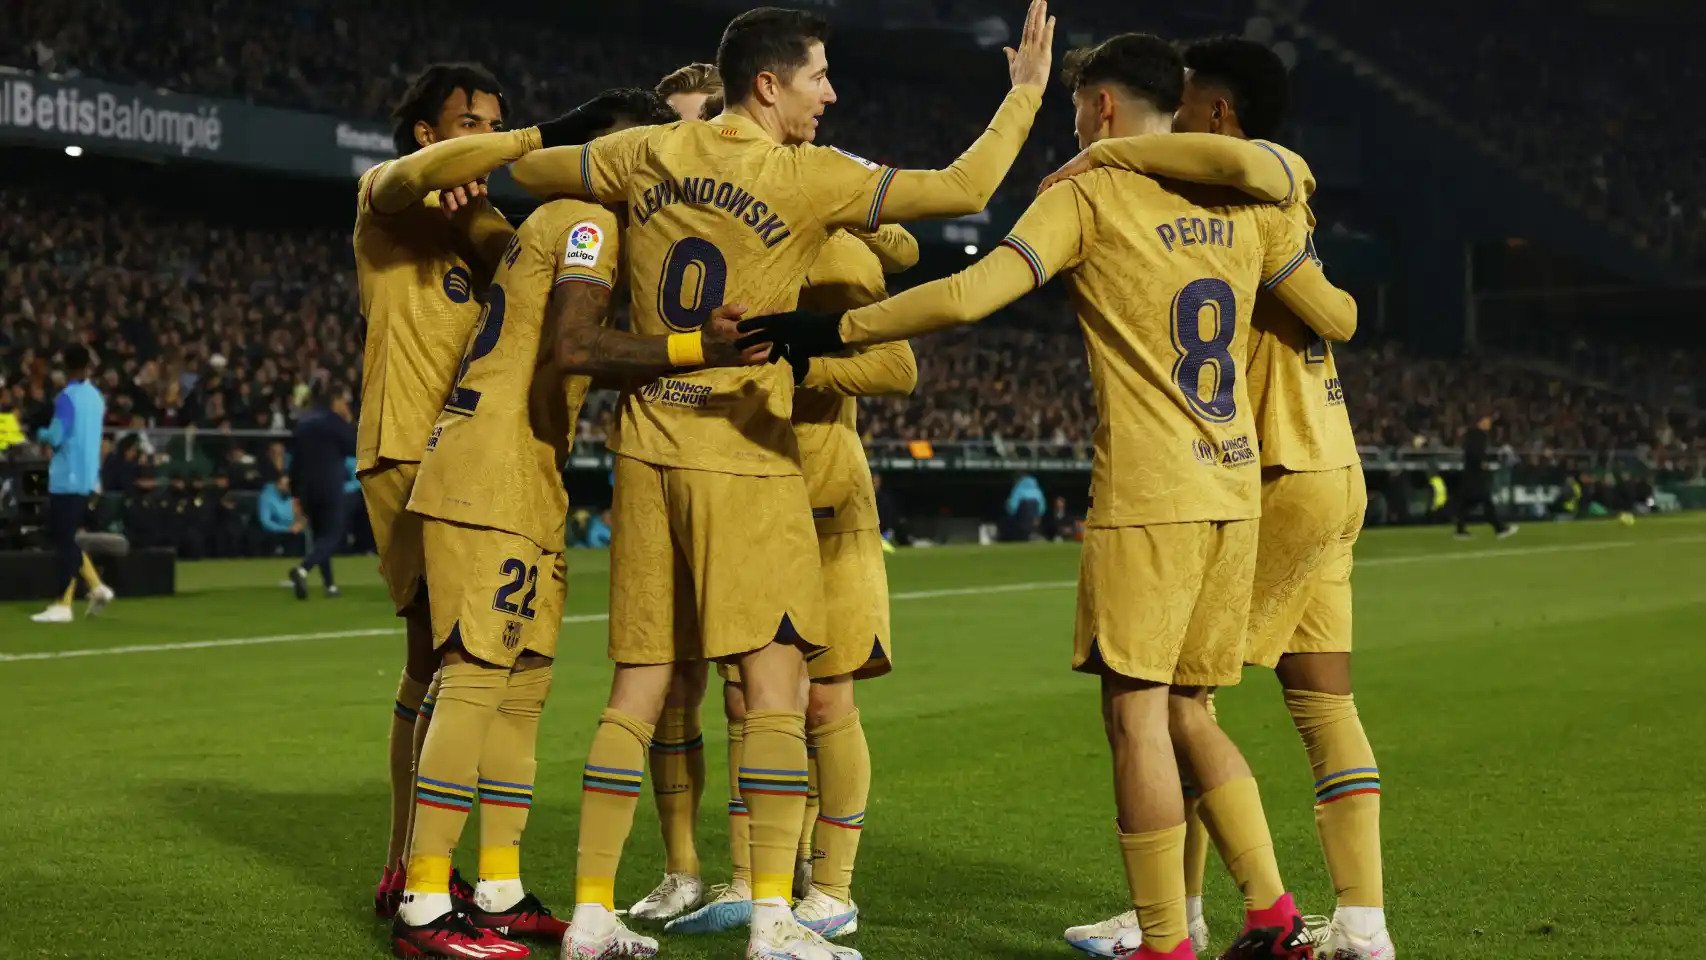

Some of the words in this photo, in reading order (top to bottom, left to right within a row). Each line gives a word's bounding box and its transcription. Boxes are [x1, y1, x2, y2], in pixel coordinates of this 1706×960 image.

[0, 79, 221, 156] lBetisBalompié
[1154, 216, 1234, 252] PEDRI
[567, 250, 595, 261] LaLiga
[1170, 277, 1236, 423] 8
[665, 379, 712, 394] UNHCR
[662, 389, 708, 406] ACNUR
[1221, 436, 1248, 452] UNHCR
[1222, 447, 1255, 463] ACNUR
[492, 558, 538, 620] 22
